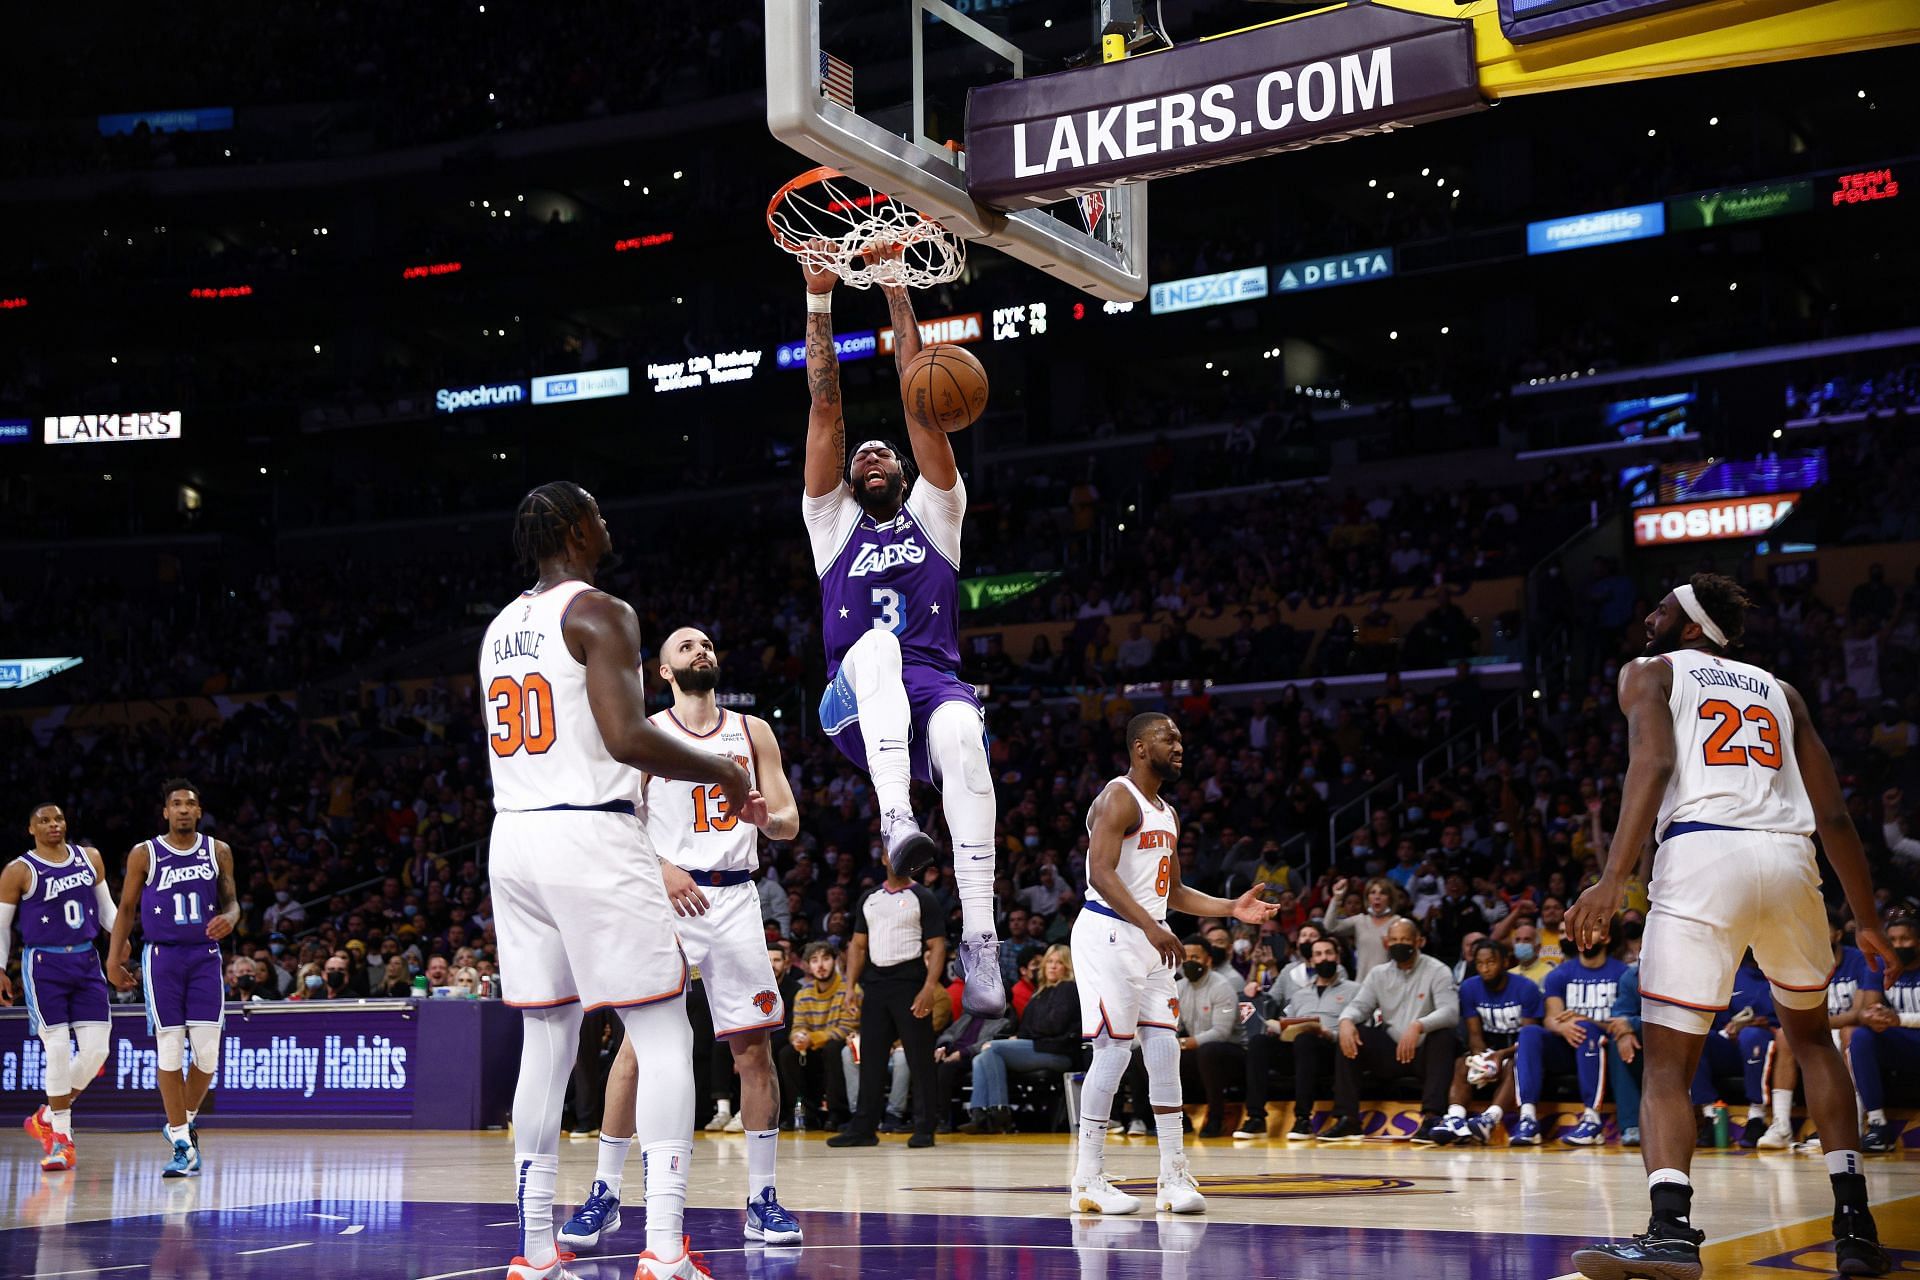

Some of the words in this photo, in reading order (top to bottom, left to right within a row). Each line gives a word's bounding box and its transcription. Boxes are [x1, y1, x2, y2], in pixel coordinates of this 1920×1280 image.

[1013, 46, 1394, 178] LAKERS.COM
[1832, 182, 1899, 206] FOULS
[1839, 169, 1893, 189] TEAM
[1304, 254, 1388, 284] DELTA
[993, 306, 1025, 324] NYK
[1073, 303, 1085, 320] 3
[880, 317, 981, 350] THIBA
[993, 323, 1020, 341] LAL
[793, 335, 876, 361] cro.com
[436, 382, 521, 413] Spectrum
[57, 413, 171, 439] LAKERS
[871, 587, 907, 637] 3
[494, 630, 544, 664] RANDLE
[1689, 667, 1770, 700] ROBINSON
[488, 672, 557, 758] 30
[1698, 698, 1783, 771] 23
[691, 784, 739, 833] 13
[44, 869, 94, 901] LAKERS
[156, 863, 215, 891] LAKERS
[1155, 855, 1170, 897] 8
[64, 900, 84, 929] 0
[172, 892, 202, 925] 11
[1566, 982, 1617, 1008] BLACK
[223, 1036, 319, 1098] Healthy
[324, 1035, 407, 1090] Habits
